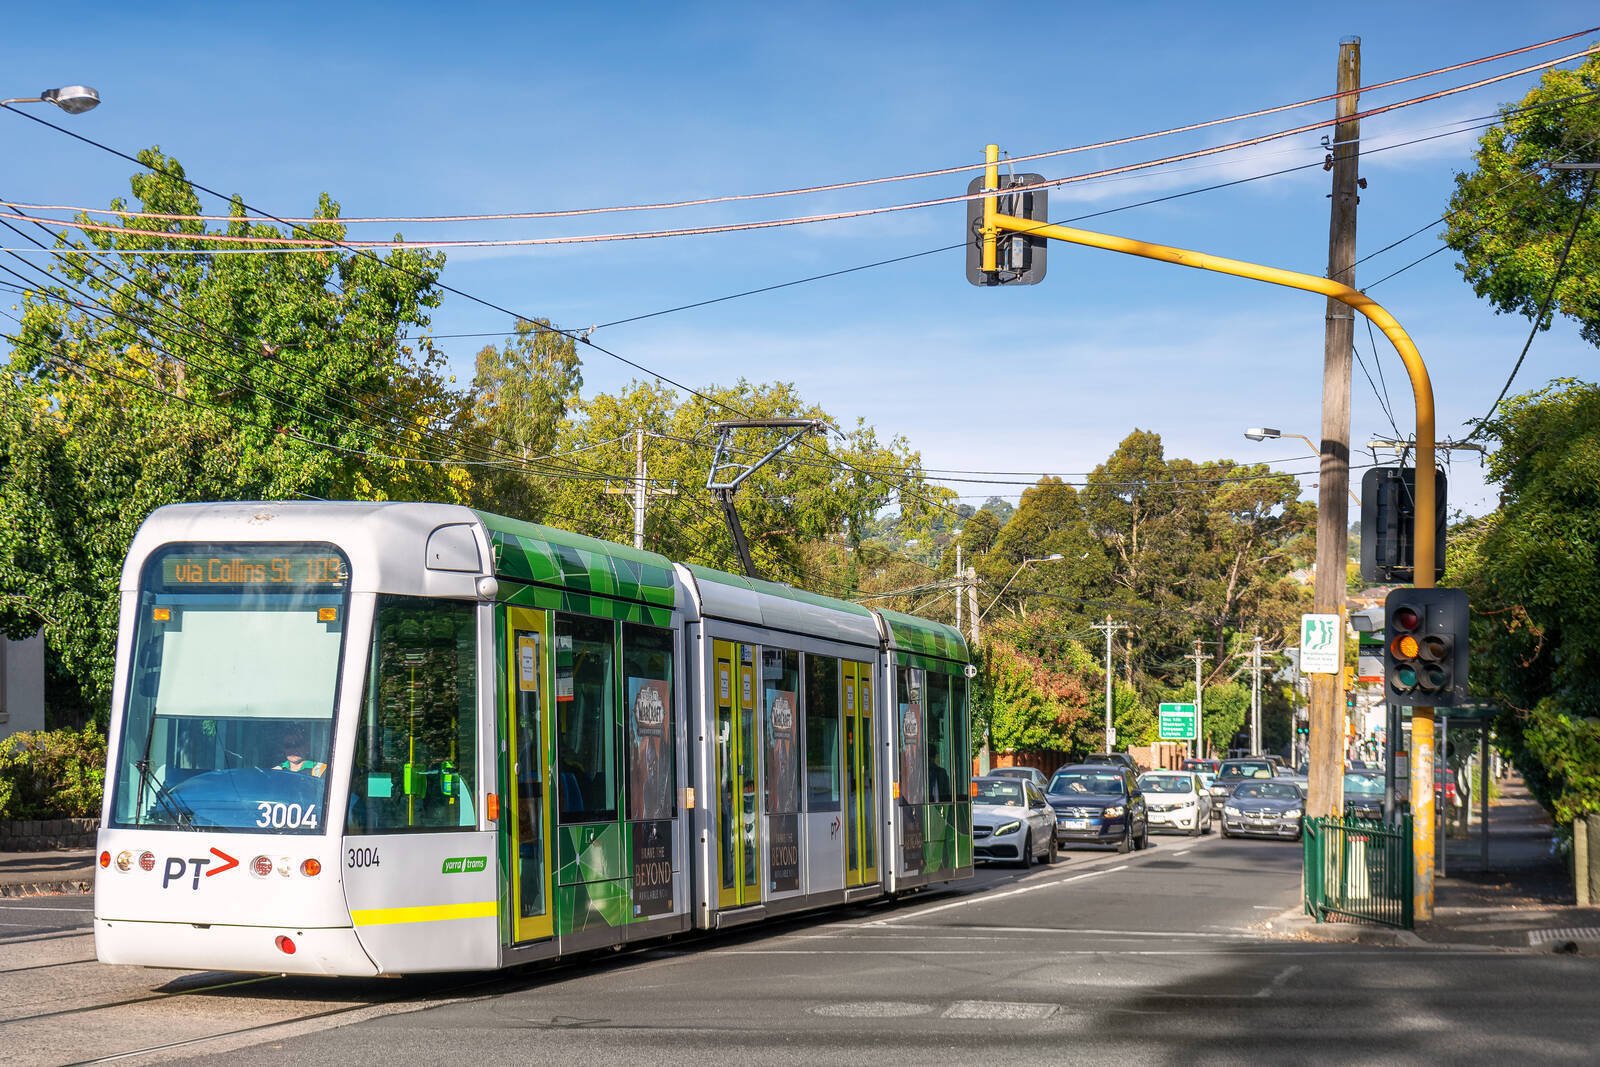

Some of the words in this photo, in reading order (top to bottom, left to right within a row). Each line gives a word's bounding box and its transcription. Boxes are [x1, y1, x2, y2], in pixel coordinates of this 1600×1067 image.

[175, 559, 203, 583] via
[207, 558, 265, 583] Collins
[271, 558, 294, 583] St
[306, 558, 342, 583] 109
[256, 803, 318, 829] 3004
[347, 847, 380, 869] 3004
[445, 861, 462, 872] yarra
[467, 860, 484, 868] trams
[771, 846, 798, 866] BEYOND
[635, 862, 671, 887] BEYOND
